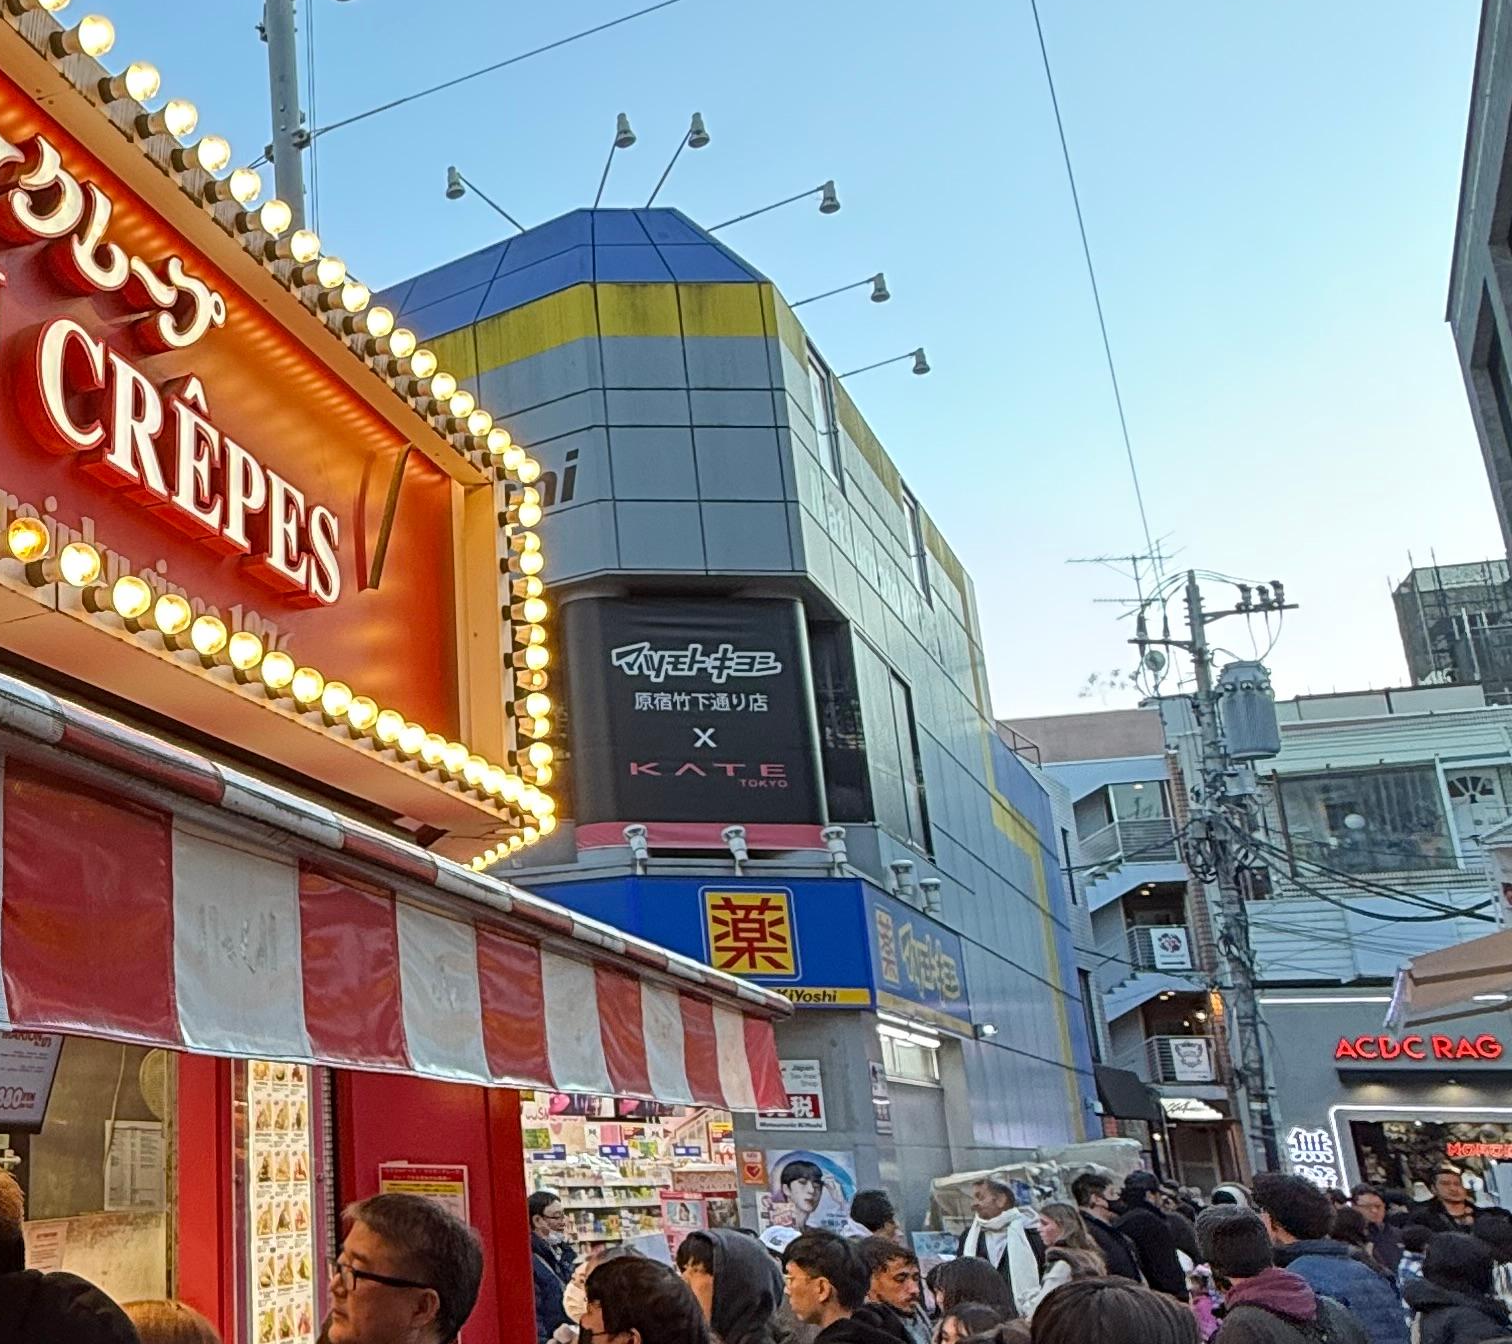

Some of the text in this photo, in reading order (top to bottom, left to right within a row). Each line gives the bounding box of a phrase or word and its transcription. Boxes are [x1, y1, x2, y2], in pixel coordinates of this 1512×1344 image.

[38, 317, 342, 607] CRÊPES
[611, 641, 782, 684] マツモトキヨシ
[634, 691, 769, 712] 原宿竹下通り店
[630, 761, 787, 778] KATE
[741, 778, 788, 788] TOKYO
[710, 896, 790, 971] 薬
[1335, 1033, 1503, 1060] ACDC RAG
